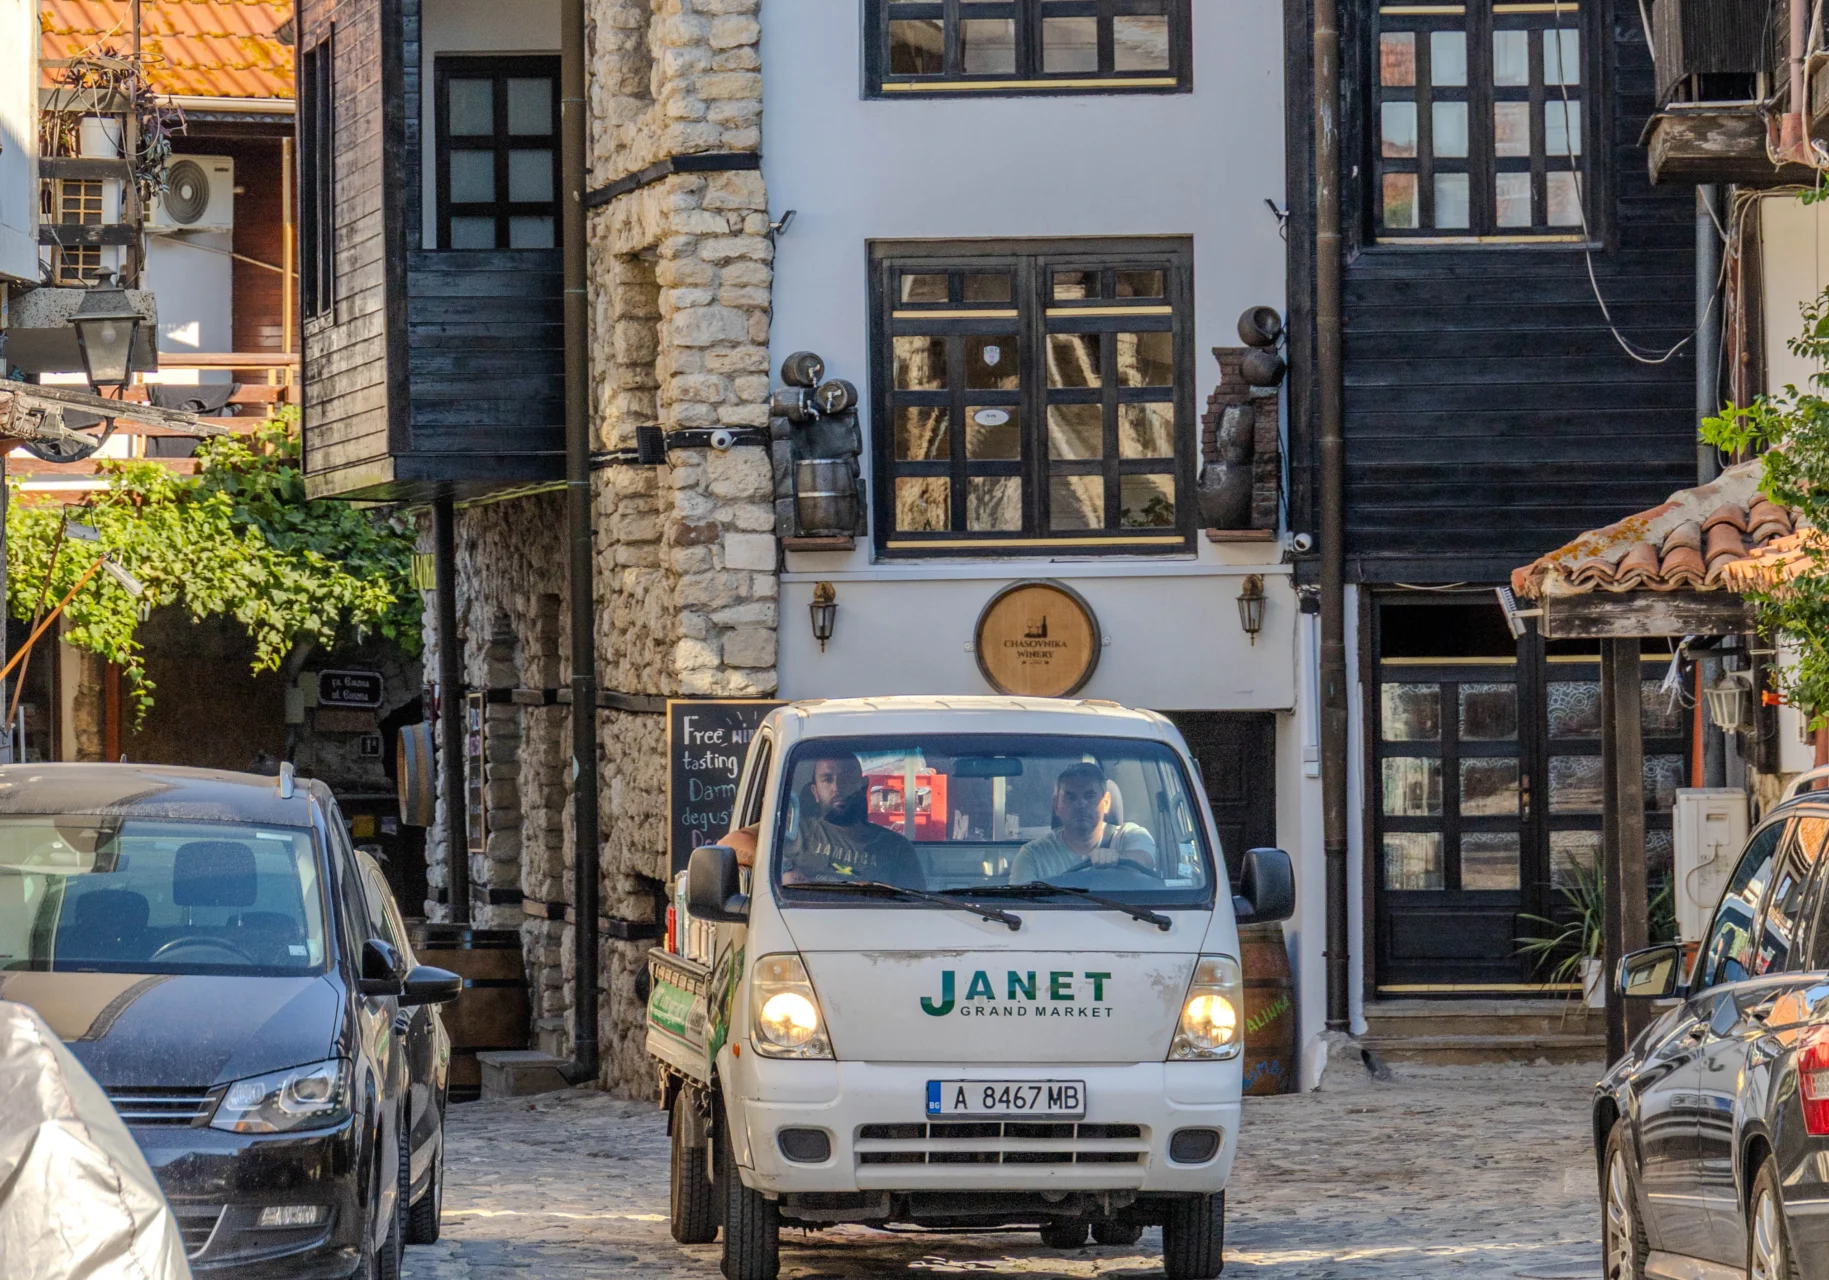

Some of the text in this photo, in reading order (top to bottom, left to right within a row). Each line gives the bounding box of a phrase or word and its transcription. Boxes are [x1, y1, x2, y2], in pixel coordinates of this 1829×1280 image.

[1004, 640, 1067, 648] CHASOVNIKA
[683, 751, 738, 778] tasting
[920, 970, 1111, 1016] JANET
[960, 1006, 1113, 1017] GRAND MARKET
[954, 1086, 1079, 1109] A 8467 MB
